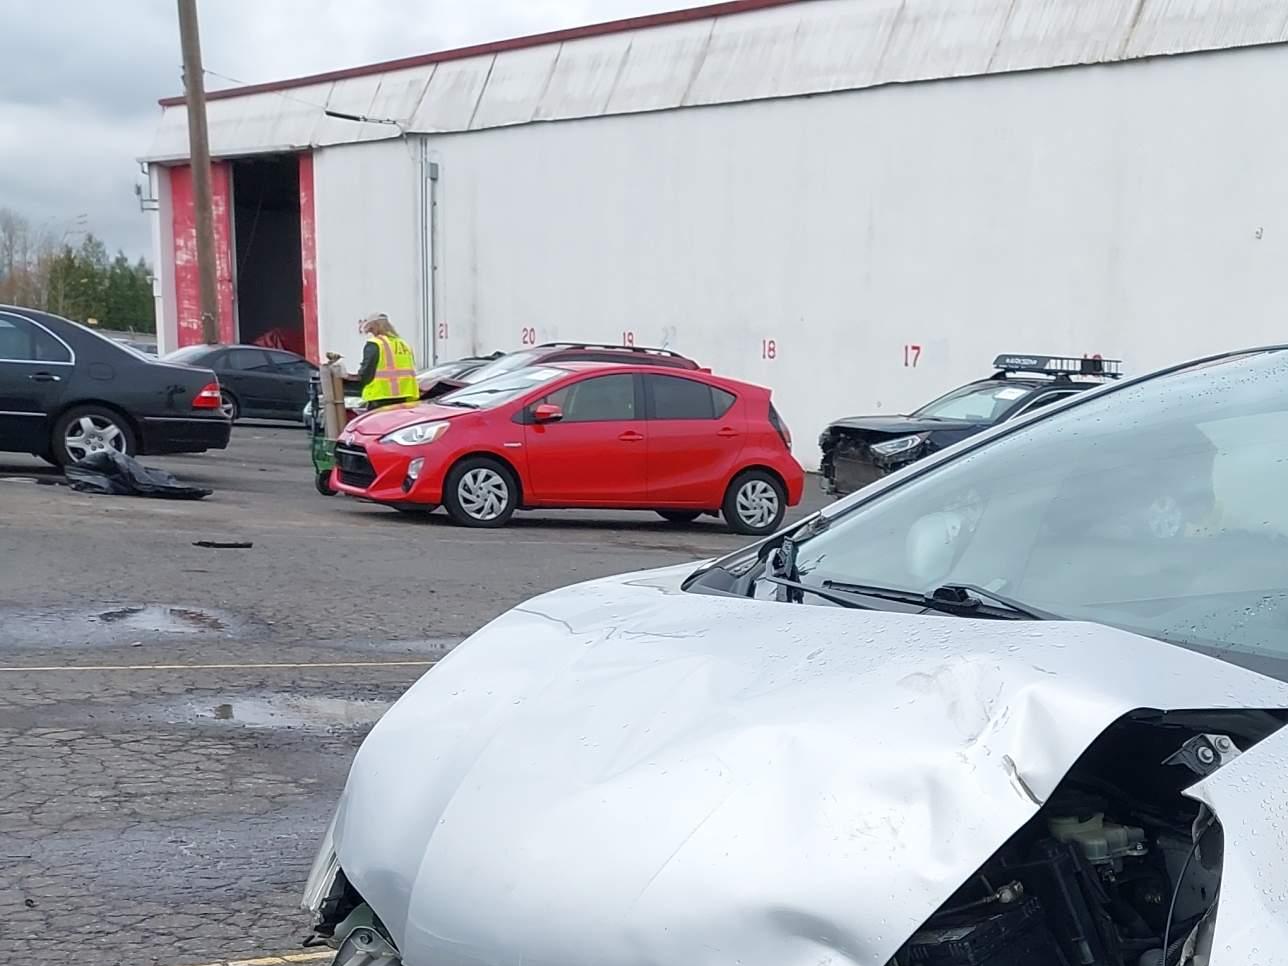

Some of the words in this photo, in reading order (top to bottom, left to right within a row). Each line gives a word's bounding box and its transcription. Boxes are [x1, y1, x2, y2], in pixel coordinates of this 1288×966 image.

[439, 323, 449, 339] 21
[522, 328, 536, 345] 20
[623, 332, 634, 346] 19
[762, 339, 776, 359] 18
[904, 344, 921, 367] 17
